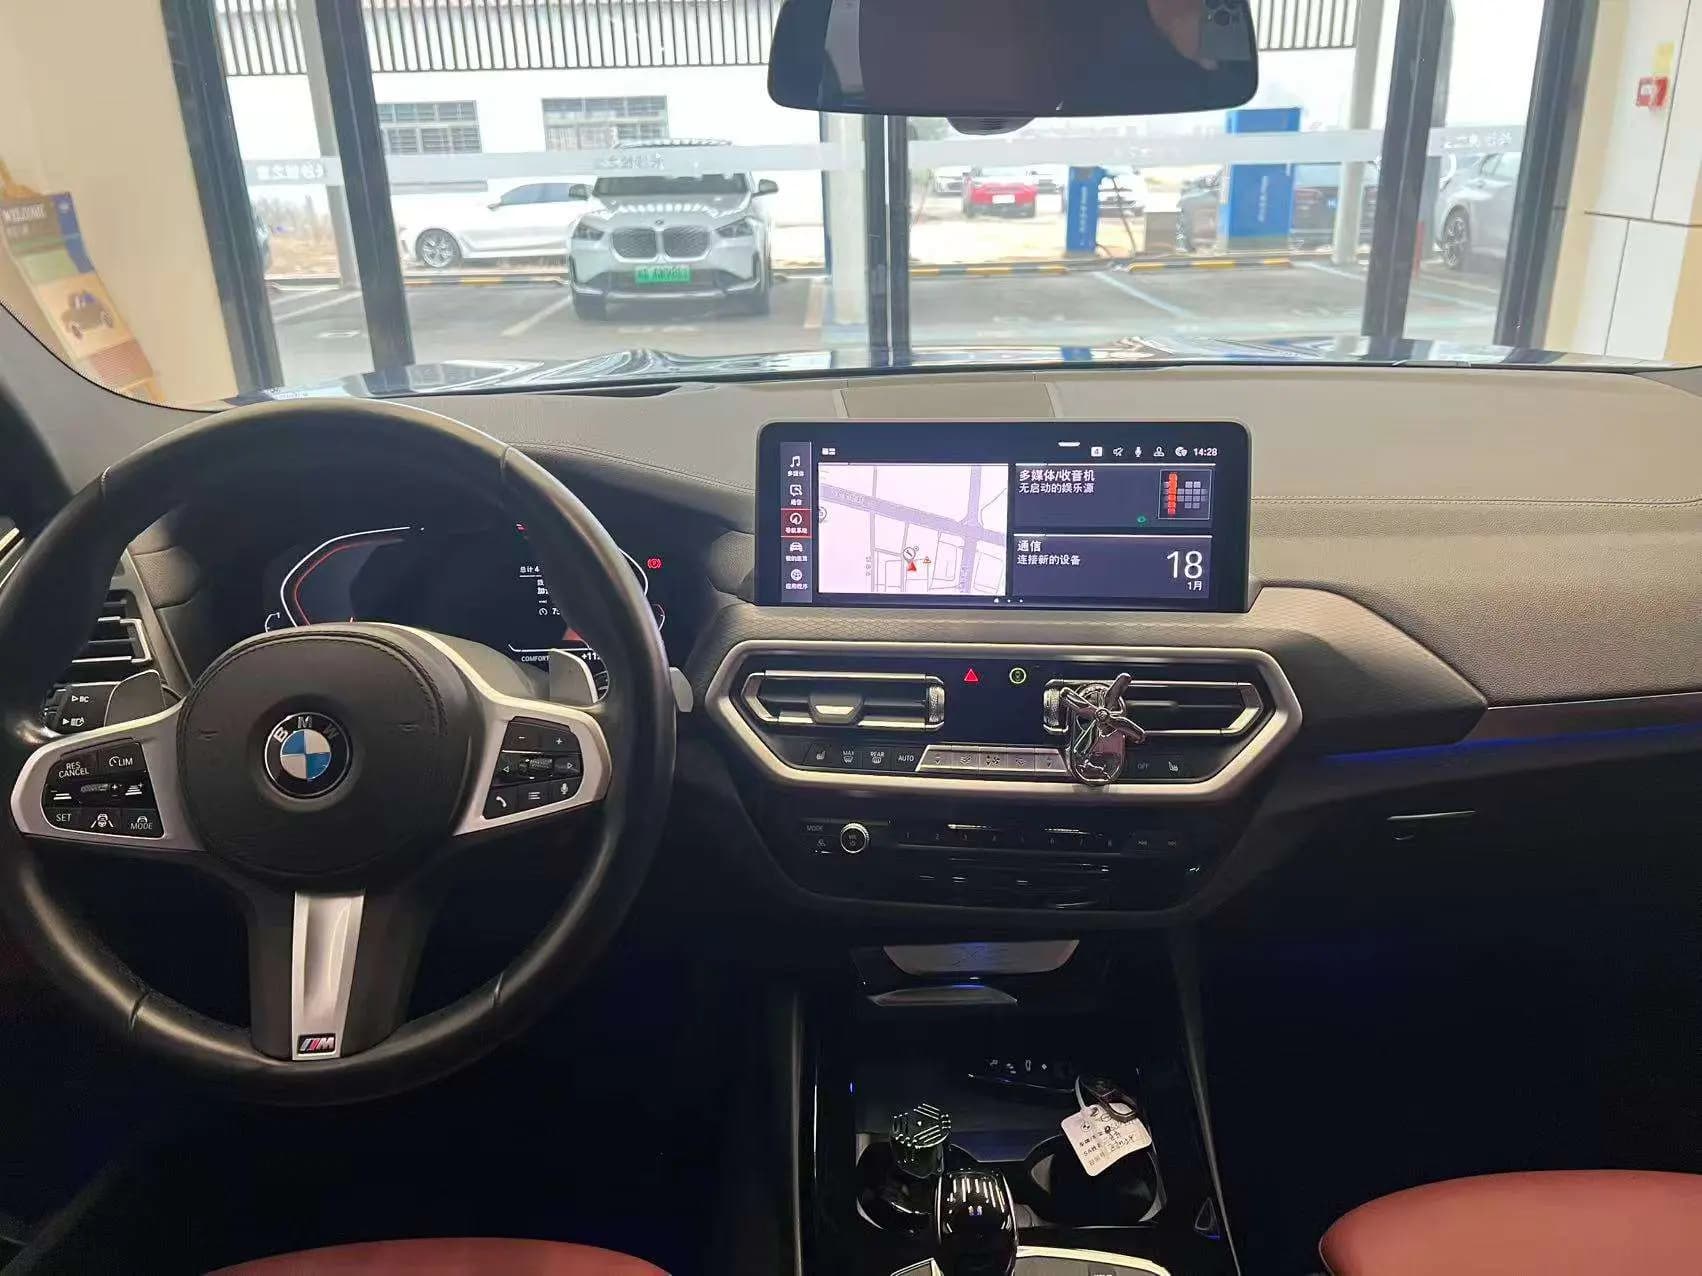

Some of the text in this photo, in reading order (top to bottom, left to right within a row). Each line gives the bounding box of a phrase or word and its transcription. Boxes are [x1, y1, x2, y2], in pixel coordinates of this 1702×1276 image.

[1193, 447, 1218, 457] 14:28
[1019, 469, 1096, 482] 多媒体/收音机
[1018, 483, 1095, 494] 无启动的娱乐源
[1017, 540, 1042, 552] 通信
[1017, 554, 1081, 566] 连接新的设备
[1166, 550, 1203, 579] 18
[1187, 581, 1203, 591] 1月
[273, 715, 339, 743] BMW
[66, 762, 81, 771] RES
[118, 757, 134, 766] LIM
[58, 767, 90, 779] CANCEL
[56, 813, 72, 822] SET
[130, 822, 153, 831] MODE
